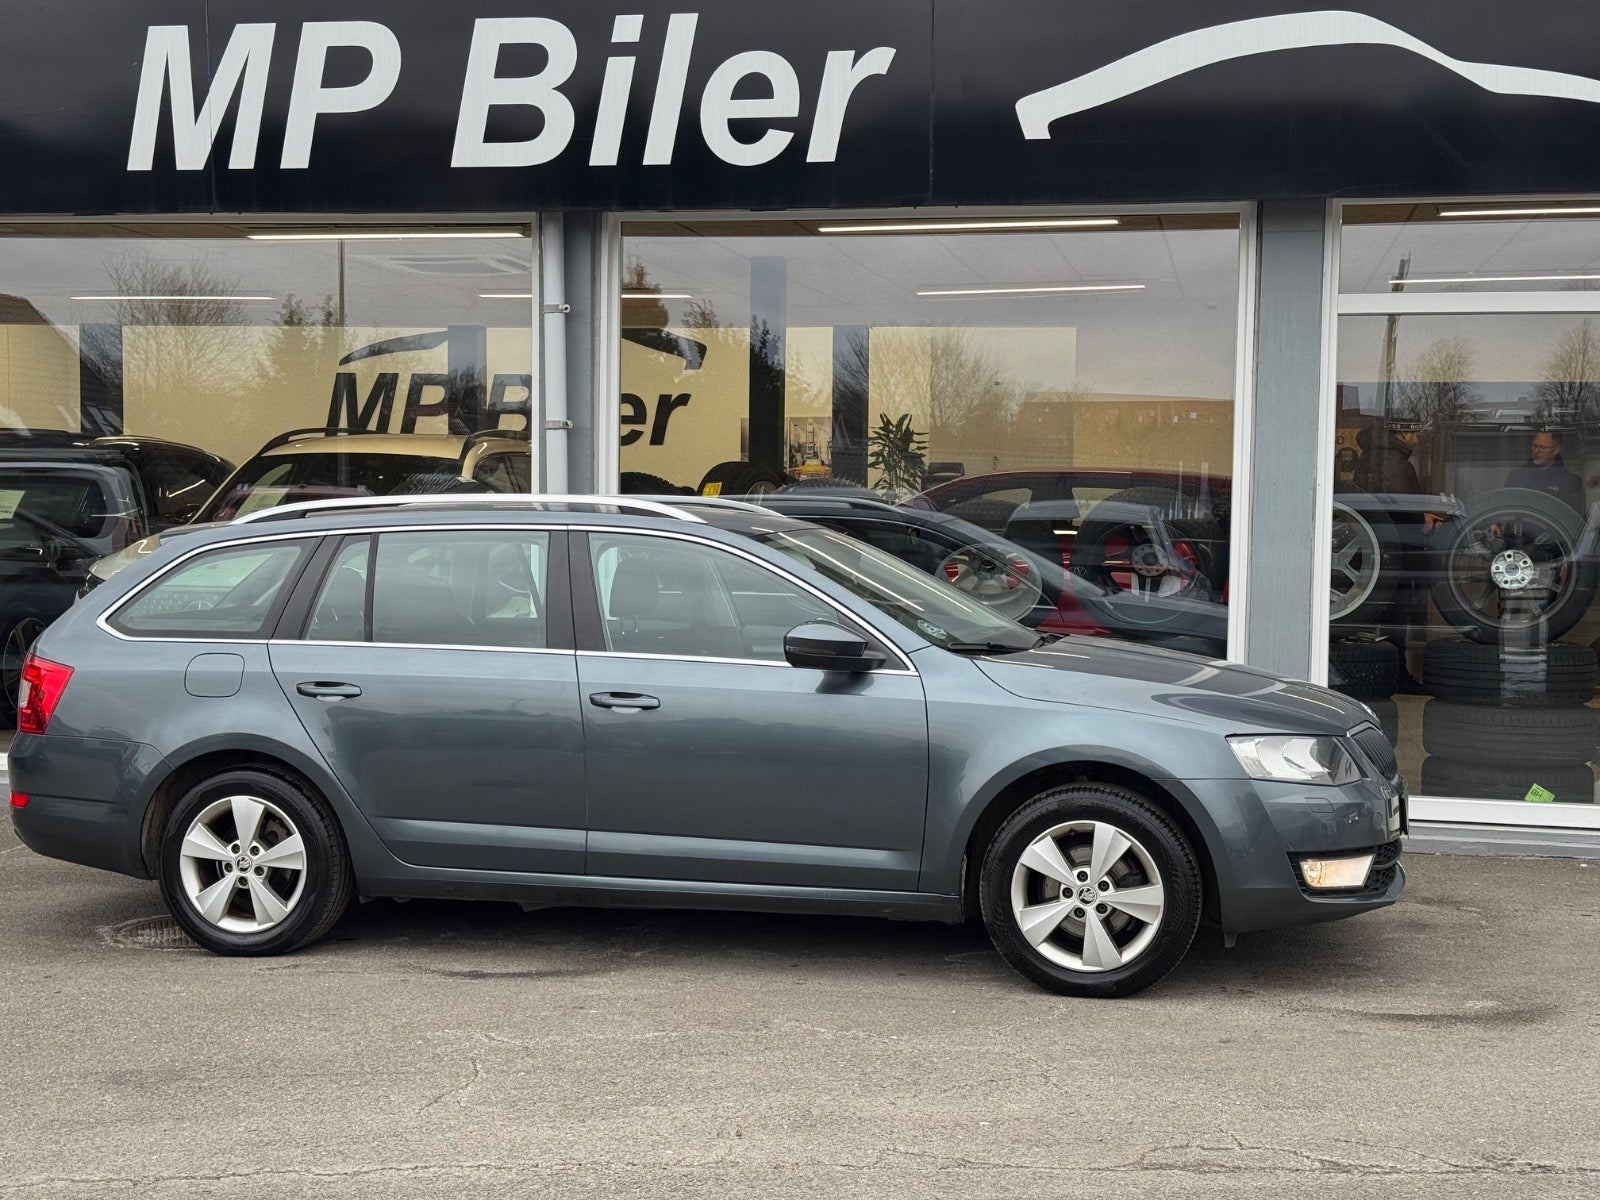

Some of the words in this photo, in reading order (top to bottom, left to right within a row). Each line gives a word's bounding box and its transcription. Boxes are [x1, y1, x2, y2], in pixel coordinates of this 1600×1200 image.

[127, 21, 402, 171] MP
[450, 12, 897, 168] Biler
[325, 372, 451, 437] MP
